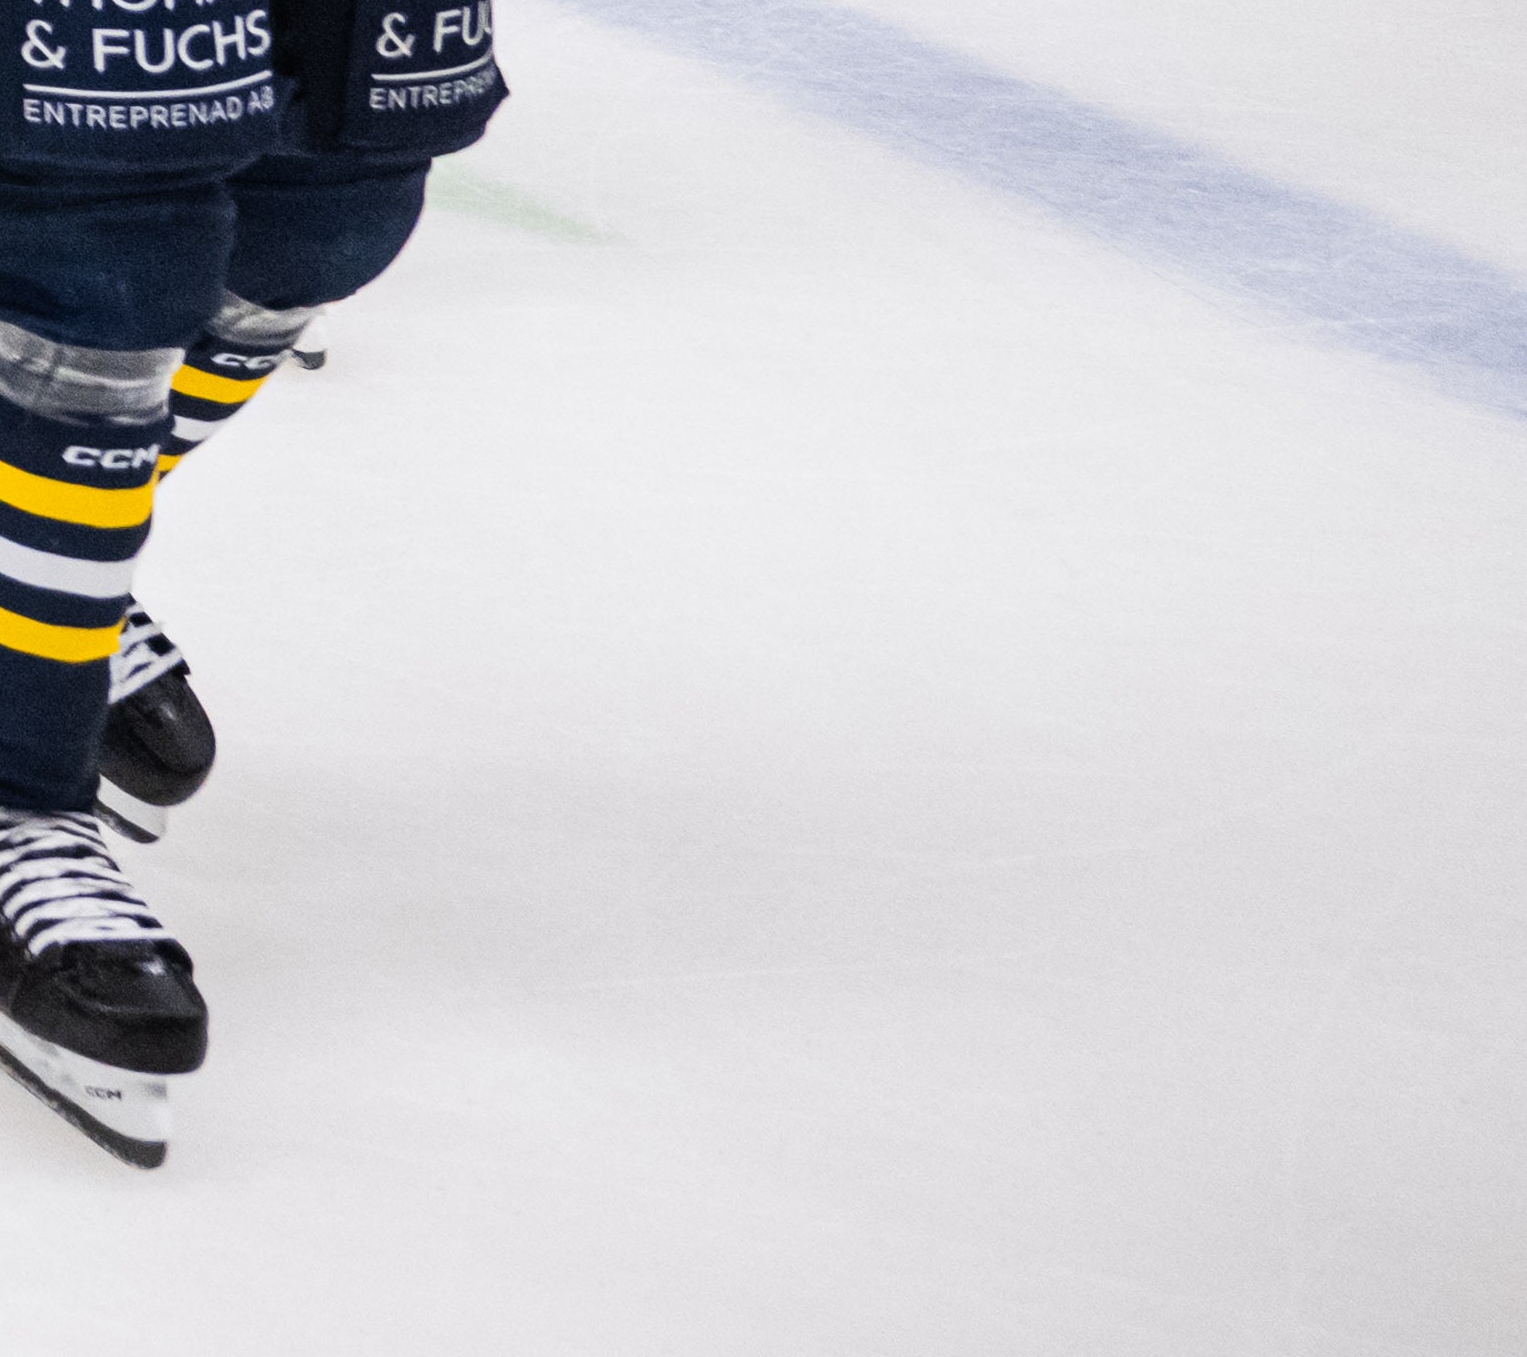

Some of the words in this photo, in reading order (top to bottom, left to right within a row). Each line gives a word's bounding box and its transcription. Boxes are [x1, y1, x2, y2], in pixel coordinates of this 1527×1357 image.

[20, 19, 67, 73] &
[91, 8, 272, 77] FUCHS
[374, 13, 416, 62] &
[22, 93, 244, 131] ENTREPRENAD
[62, 443, 161, 472] CCM
